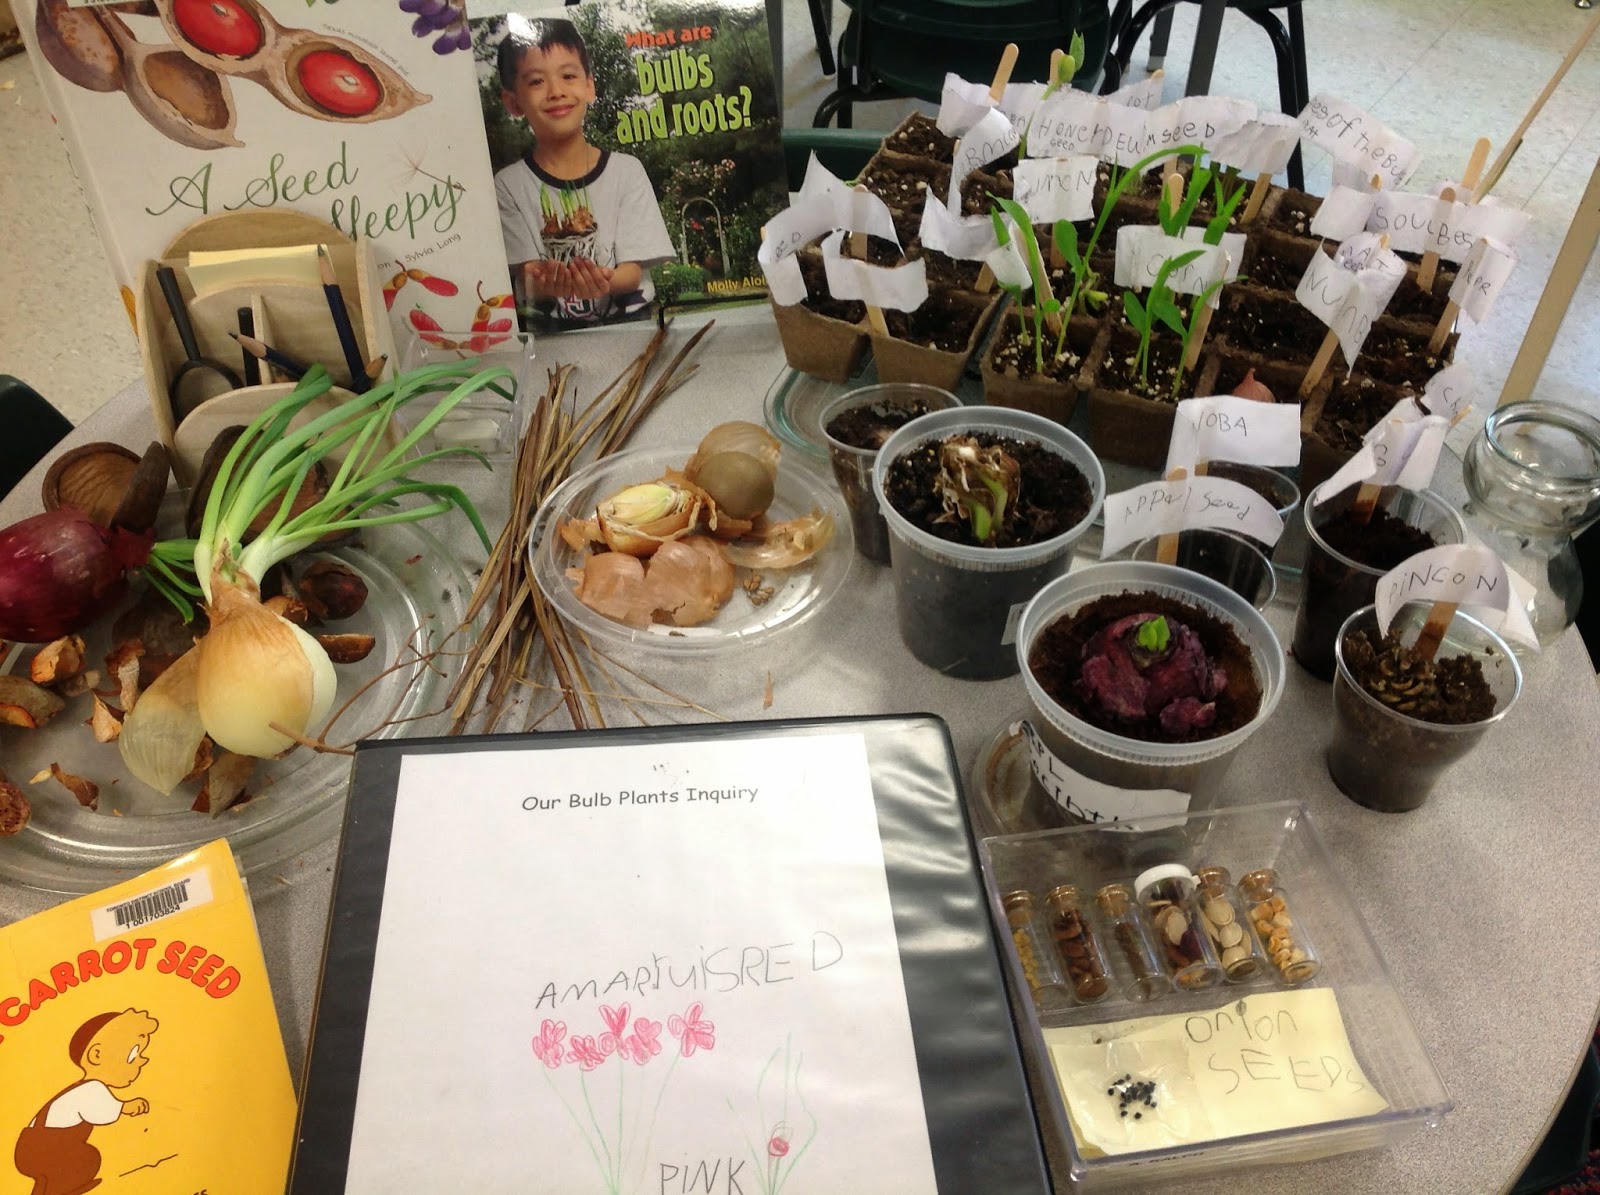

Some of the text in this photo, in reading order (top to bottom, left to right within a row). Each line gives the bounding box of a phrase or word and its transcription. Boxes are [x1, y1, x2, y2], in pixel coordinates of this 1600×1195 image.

[625, 24, 712, 48] What are
[635, 48, 714, 95] bulbs
[616, 85, 752, 144] and roots?
[145, 140, 360, 216] A Seed
[405, 247, 434, 263] Sylvia
[436, 232, 462, 251] Long
[706, 279, 738, 293] Molly
[521, 785, 759, 811] Our Bulb Plants Inquiry
[0, 938, 242, 1027] CARROT SEED
